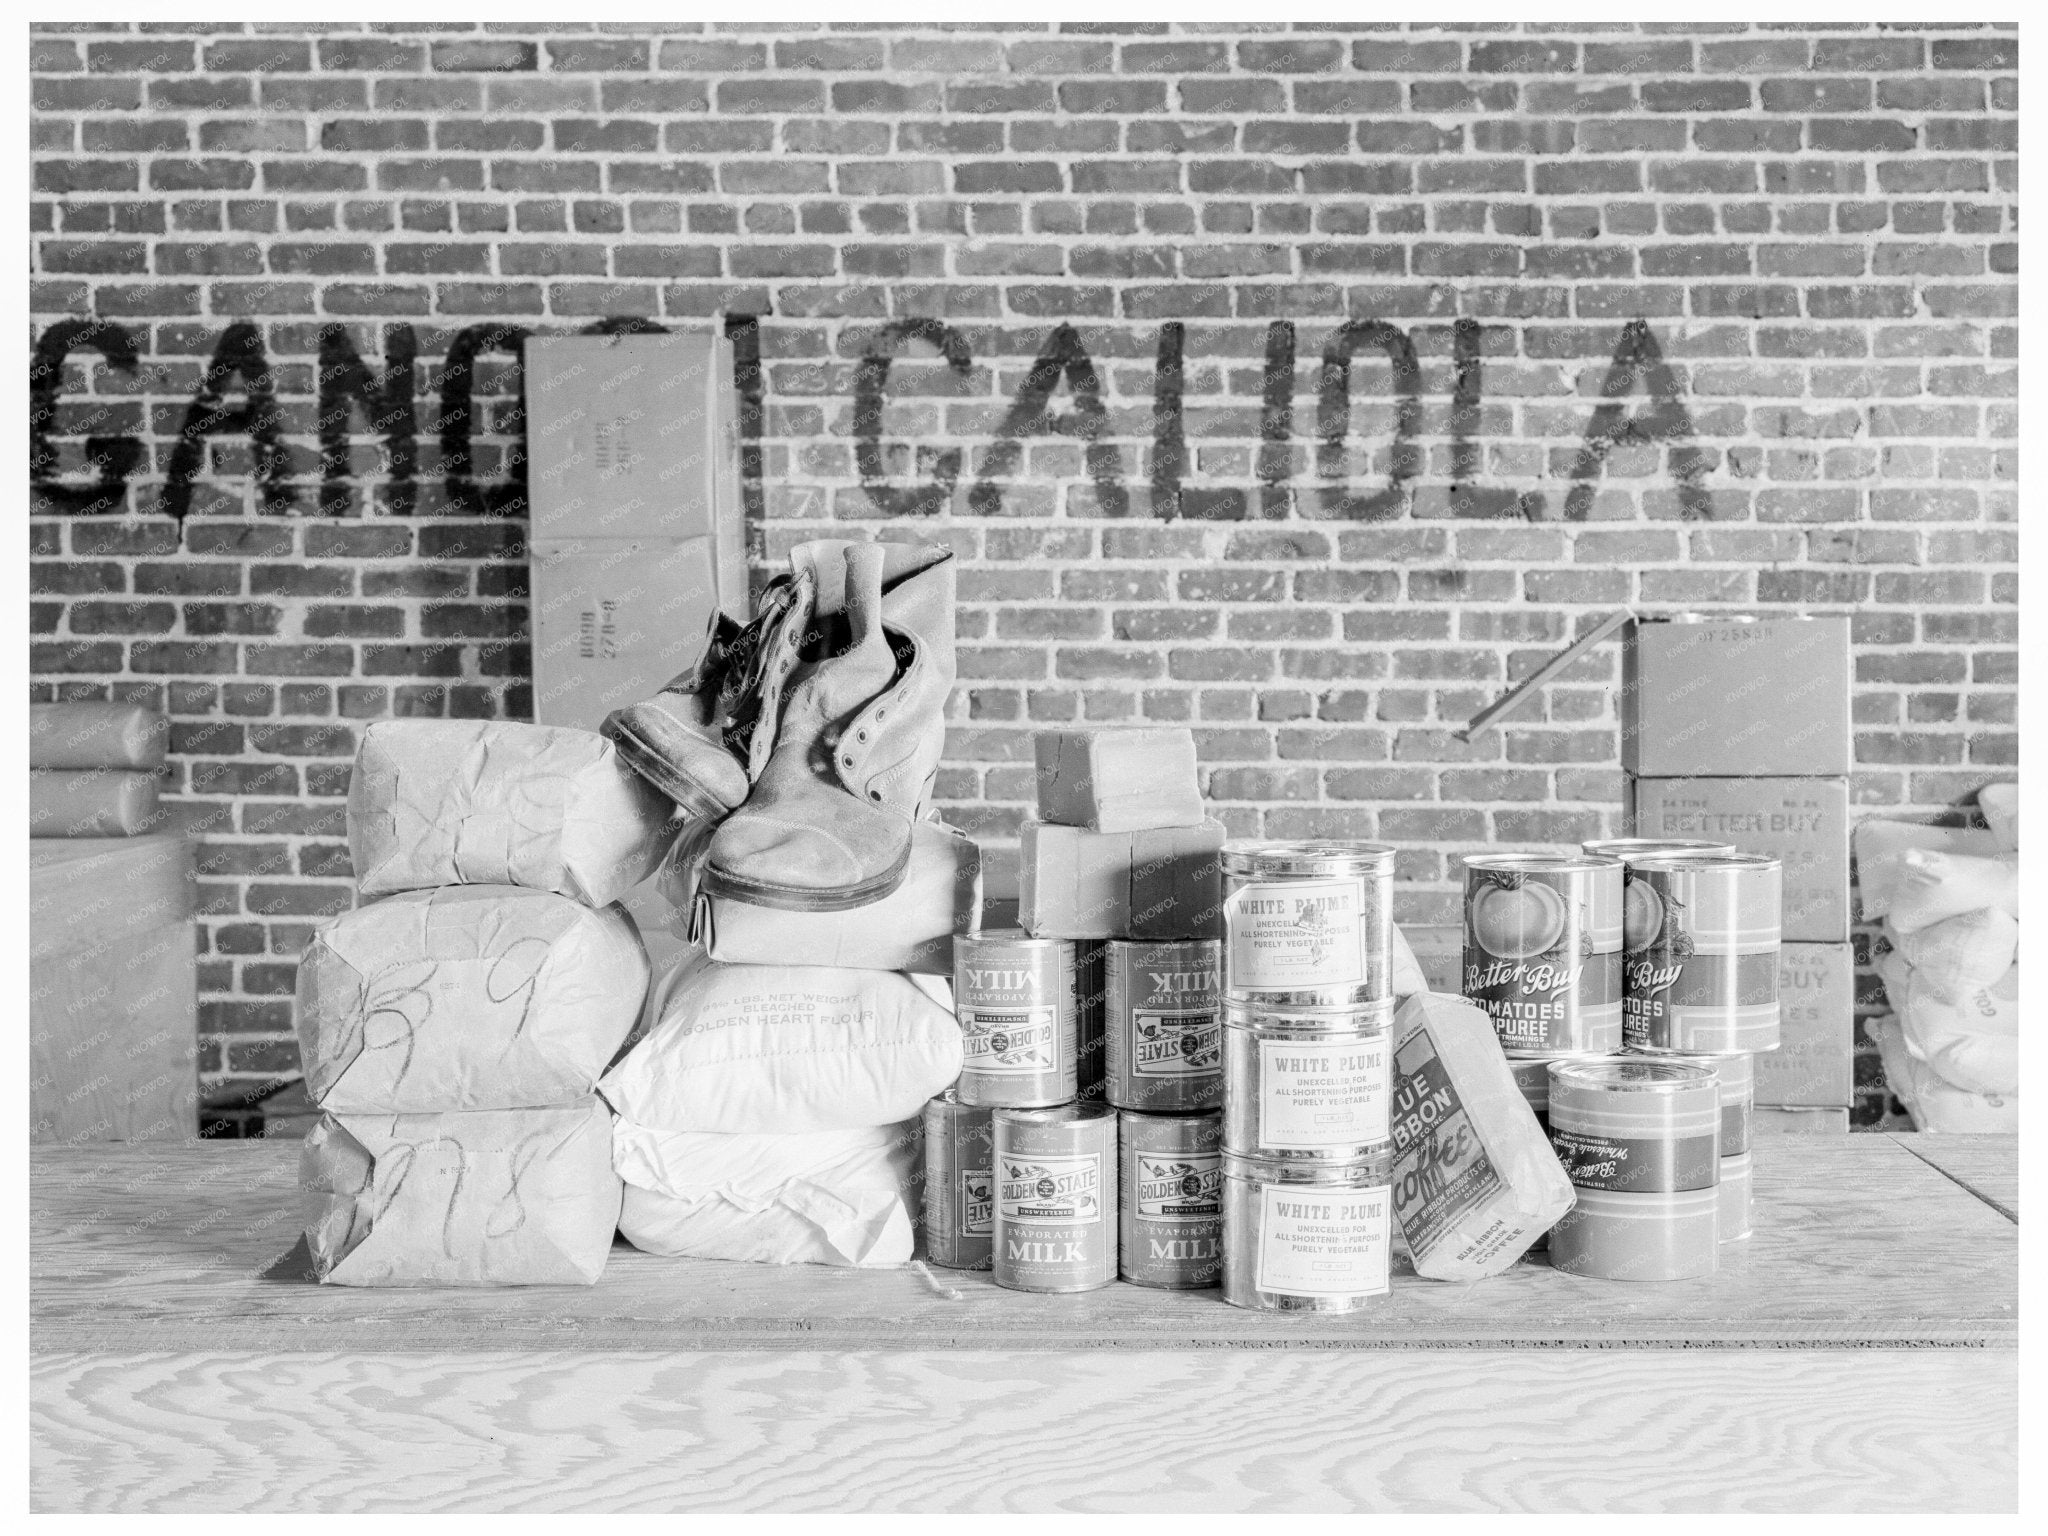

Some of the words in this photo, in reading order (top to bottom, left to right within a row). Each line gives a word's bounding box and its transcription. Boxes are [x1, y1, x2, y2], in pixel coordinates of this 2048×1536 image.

[1664, 814, 1762, 831] BETTER
[1771, 814, 1821, 831] BUY
[1238, 900, 1285, 915] WHITE
[1295, 895, 1349, 913] PLUME
[1240, 930, 1252, 938] ALL
[1253, 929, 1306, 938] SHORTENING
[1254, 940, 1282, 948] PURELY
[1286, 938, 1334, 948] VEGETABLE
[966, 969, 1042, 990] MILK
[1148, 970, 1220, 992] MILK
[1465, 961, 1530, 994] Better
[1522, 963, 1584, 1001] Buy
[1631, 961, 1683, 998] Buy
[1780, 971, 1828, 988] BUY
[769, 994, 797, 1002] NET
[803, 993, 860, 1005] WEIGHT
[966, 992, 1034, 1001] VAPORATED
[744, 1003, 815, 1012] BLEACHED
[683, 1015, 750, 1036] GOLDEN
[758, 1014, 814, 1025] HEART
[821, 1010, 874, 1025] FLOUR
[976, 1015, 1028, 1023] UNSWEETENED
[1496, 1018, 1548, 1036] PUREE
[1624, 1013, 1649, 1032] UREE
[963, 1037, 989, 1055] STAT
[1501, 1033, 1545, 1043] TRIMMINGS
[1139, 1040, 1179, 1060] STATE
[1275, 1057, 1329, 1073] WHITE
[1339, 1052, 1381, 1071] PLUME
[1292, 1088, 1348, 1096] SHORTENING
[1349, 1083, 1382, 1094] PURPOSES
[1297, 1078, 1349, 1086] UNEXCELLED
[1328, 1095, 1371, 1106] VEGETABLE
[1393, 1087, 1452, 1149] BBON
[1431, 1115, 1446, 1129] INC.
[1580, 1144, 1628, 1160] Wholesale
[1571, 1160, 1617, 1178] Better
[1001, 1183, 1036, 1200] GOLDEN
[1058, 1169, 1096, 1193] STATE
[1140, 1180, 1181, 1200] GOLDEN
[1404, 1216, 1421, 1235] BLUE
[1421, 1195, 1446, 1219] RIBBON
[1445, 1168, 1479, 1196] PRODUCTS
[1411, 1234, 1421, 1246] SAN
[1464, 1171, 1493, 1199] OAKLAND
[969, 1203, 992, 1222] ATE
[1020, 1208, 1073, 1216] UNSWEETENED
[1277, 1202, 1331, 1220] WHITE
[1340, 1202, 1382, 1220] PLUME
[1008, 1227, 1087, 1239] EVAPORATED
[1275, 1233, 1290, 1241] ALL
[1349, 1233, 1380, 1243] PURPOSES
[1297, 1225, 1350, 1233] UNEXCELLED
[1352, 1225, 1367, 1233] FOR
[1149, 1238, 1221, 1260] MILK
[1292, 1244, 1324, 1253] PURELY
[1328, 1245, 1369, 1254] VEGETABLE
[1456, 1246, 1476, 1261] BLUE
[1475, 1219, 1505, 1245] RIBBON
[1476, 1228, 1525, 1264] COFFEE
[1008, 1239, 1087, 1262] MILK
